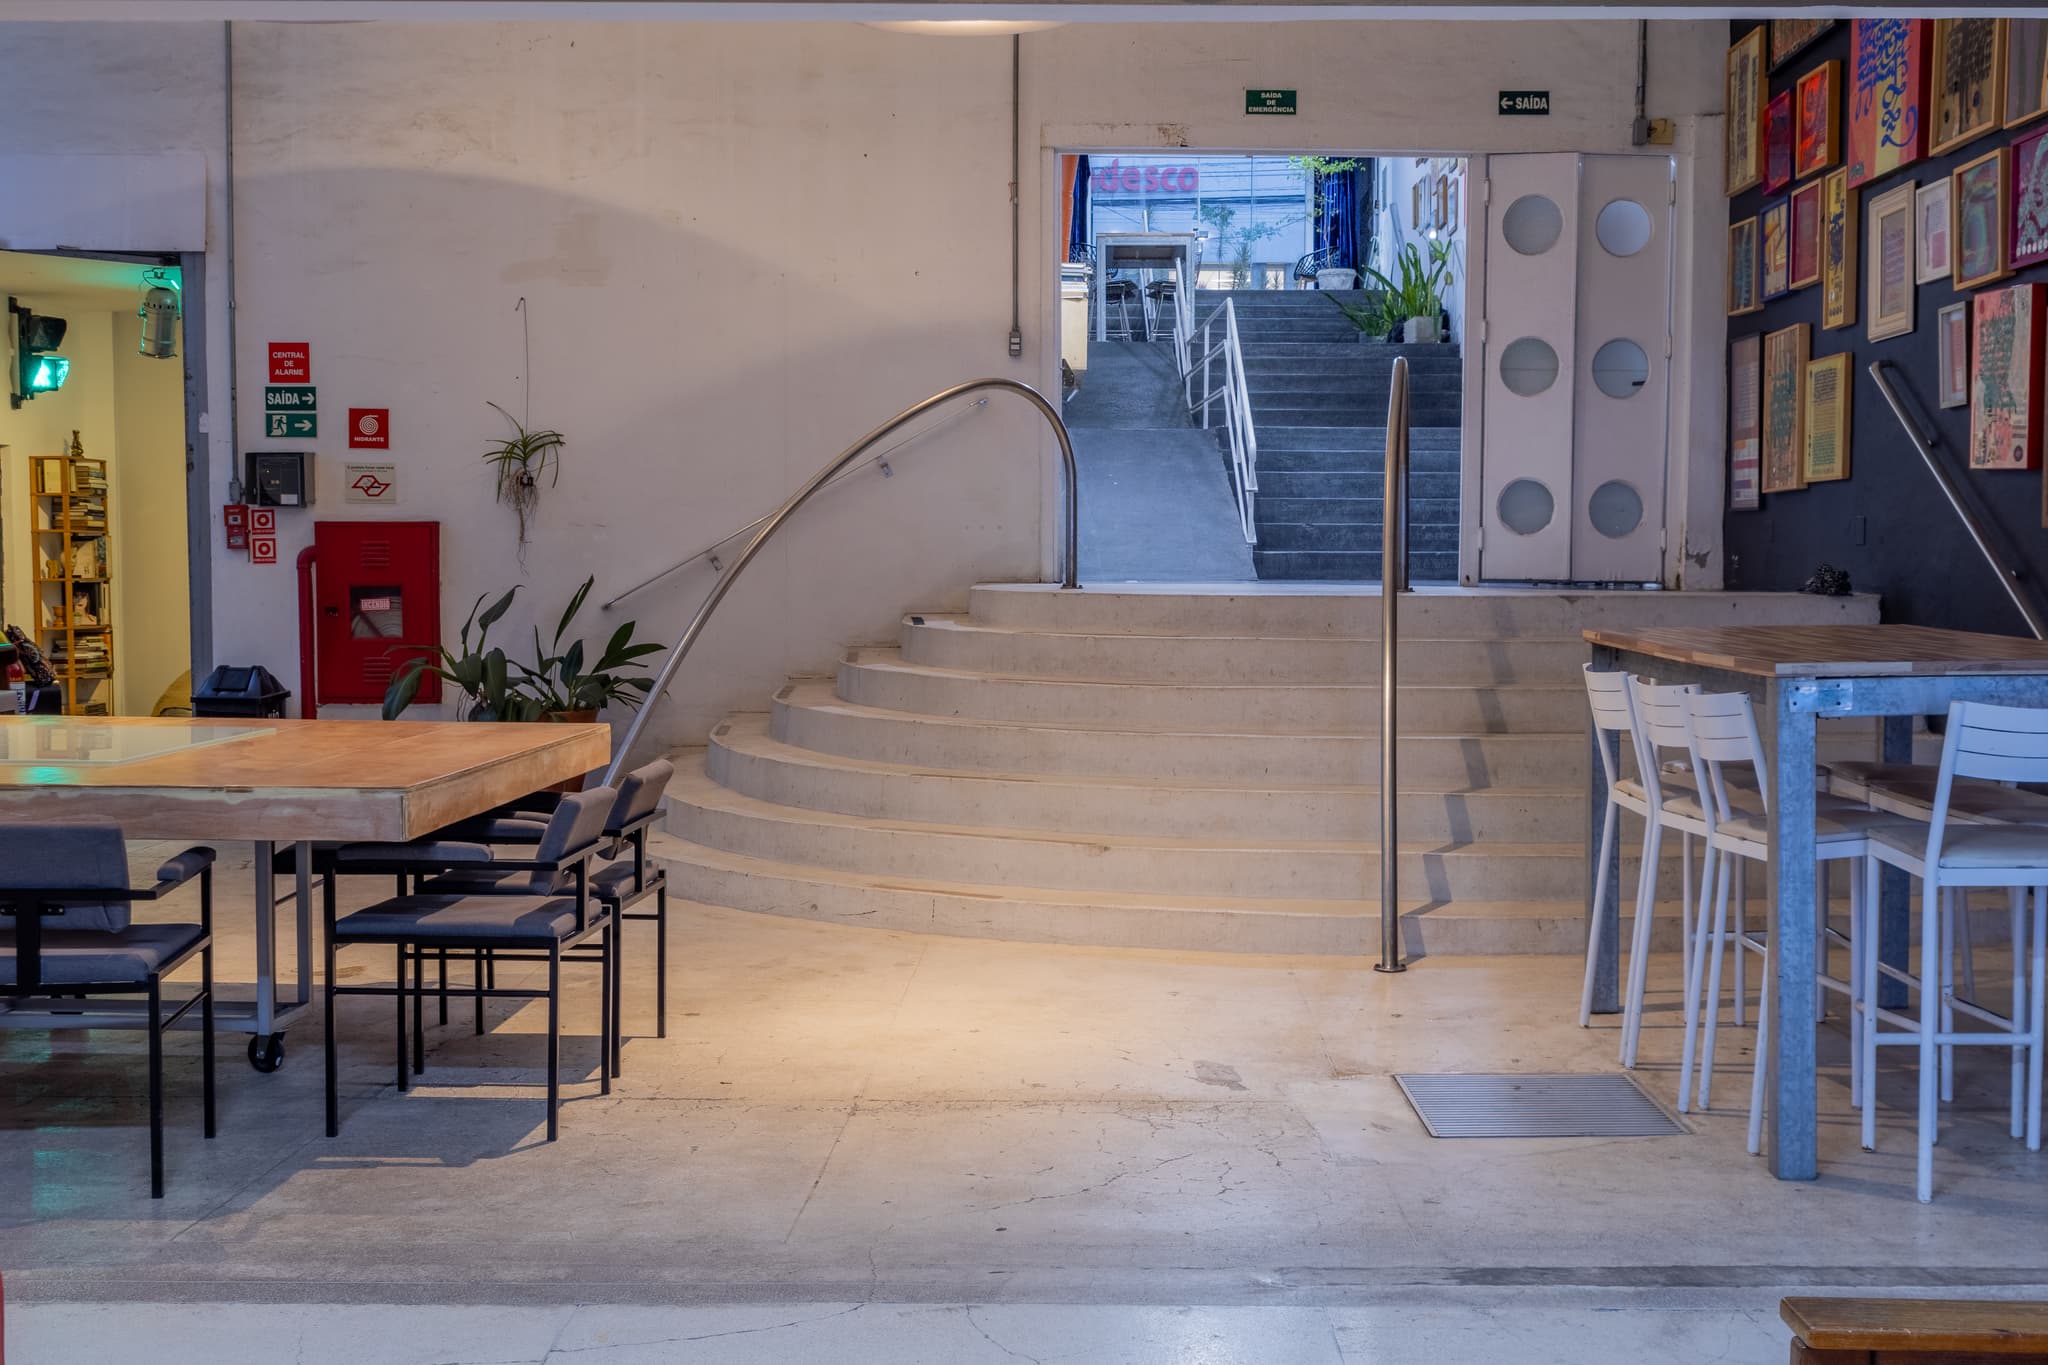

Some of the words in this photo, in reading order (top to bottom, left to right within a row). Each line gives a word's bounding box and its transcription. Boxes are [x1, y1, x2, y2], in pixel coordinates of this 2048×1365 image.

[1515, 94, 1548, 109] SAÍDA
[272, 351, 305, 359] CENTRAL
[267, 390, 300, 405] SAÍDA
